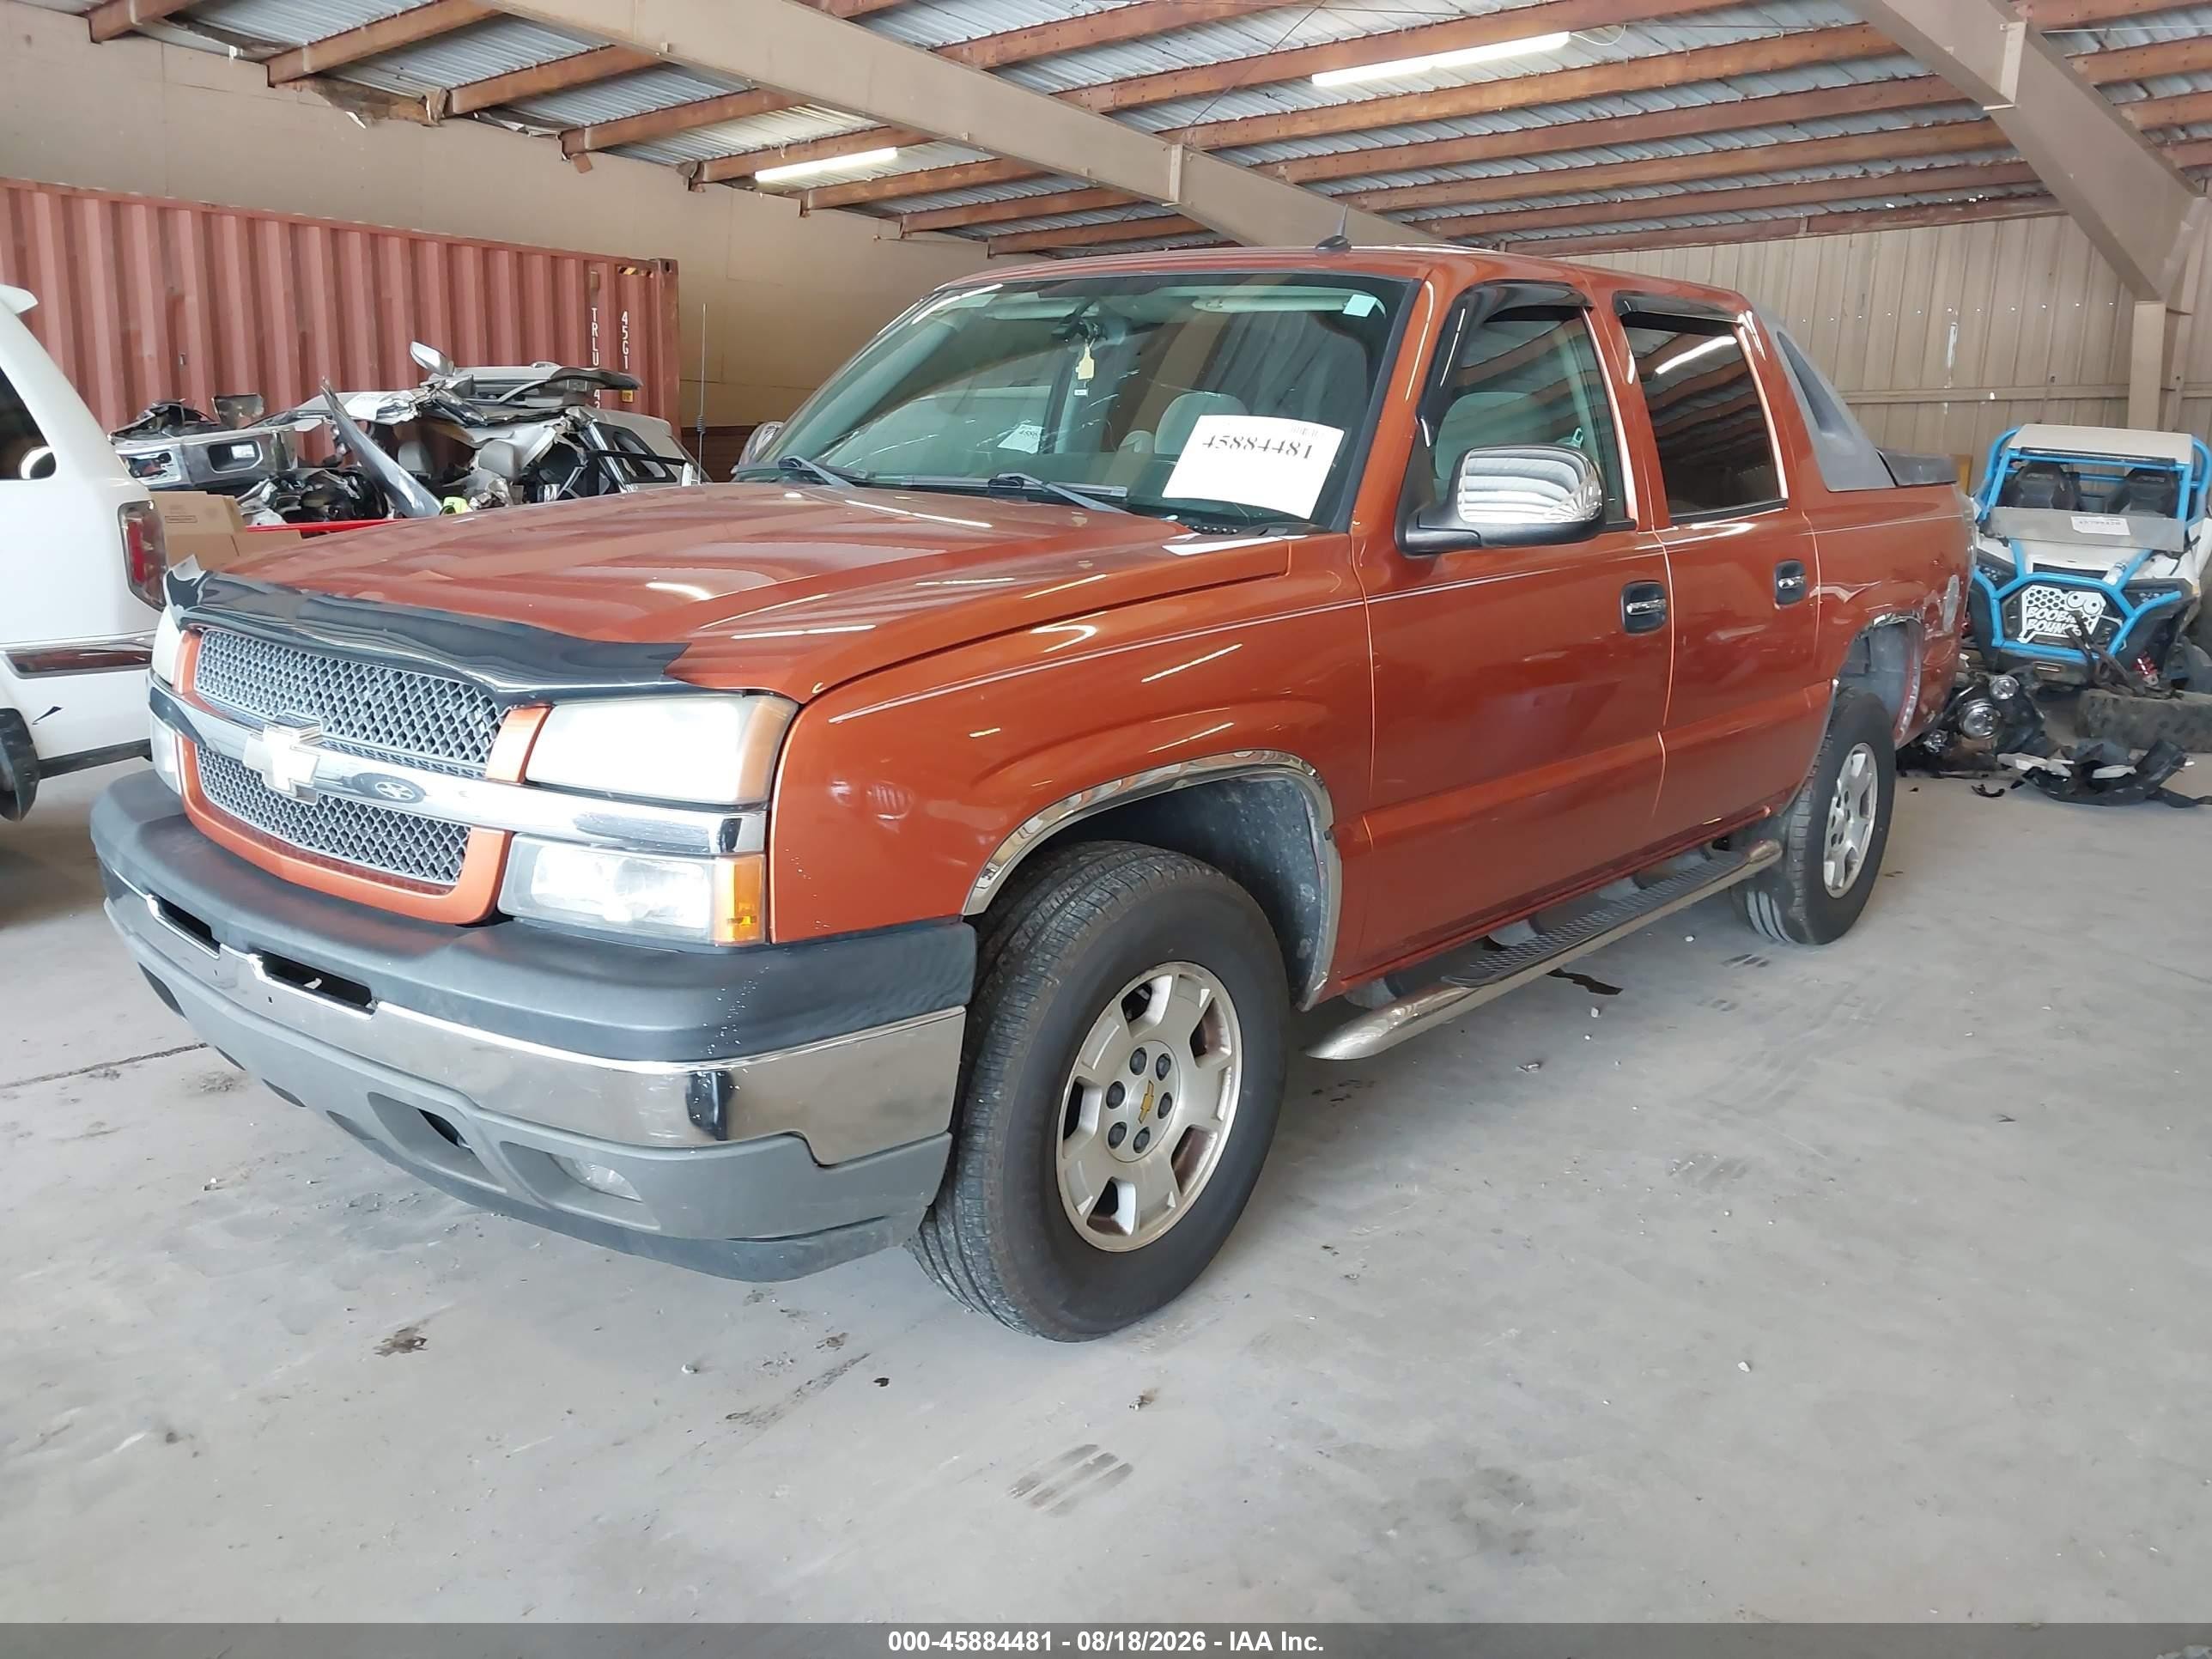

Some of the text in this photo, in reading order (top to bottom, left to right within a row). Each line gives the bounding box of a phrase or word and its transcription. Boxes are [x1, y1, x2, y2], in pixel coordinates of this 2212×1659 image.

[591, 307, 599, 366] TRLU
[621, 311, 629, 369] 45G1
[1202, 434, 1313, 459] 45884481
